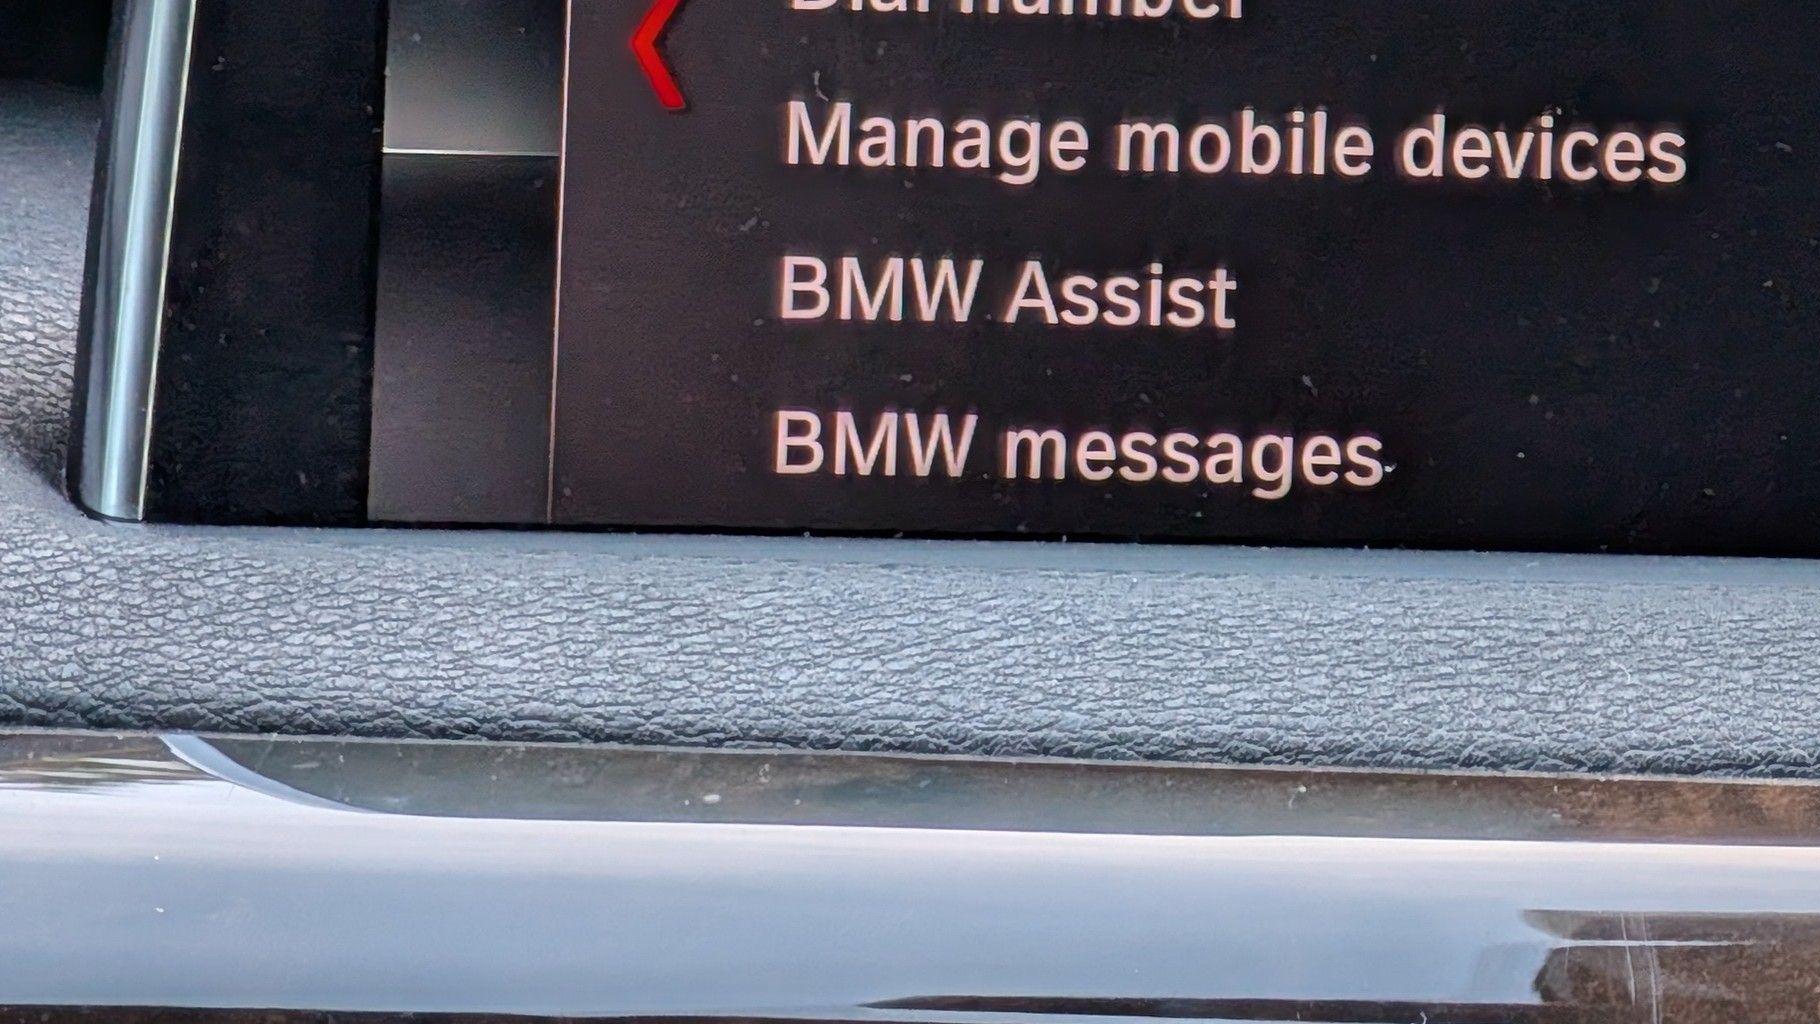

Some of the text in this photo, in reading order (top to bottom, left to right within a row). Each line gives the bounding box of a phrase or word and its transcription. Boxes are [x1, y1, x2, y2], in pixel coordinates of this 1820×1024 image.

[787, 100, 1687, 185] Manage mobile devices
[780, 255, 1237, 329] BMW Assist
[775, 409, 1386, 500] BMW messages
